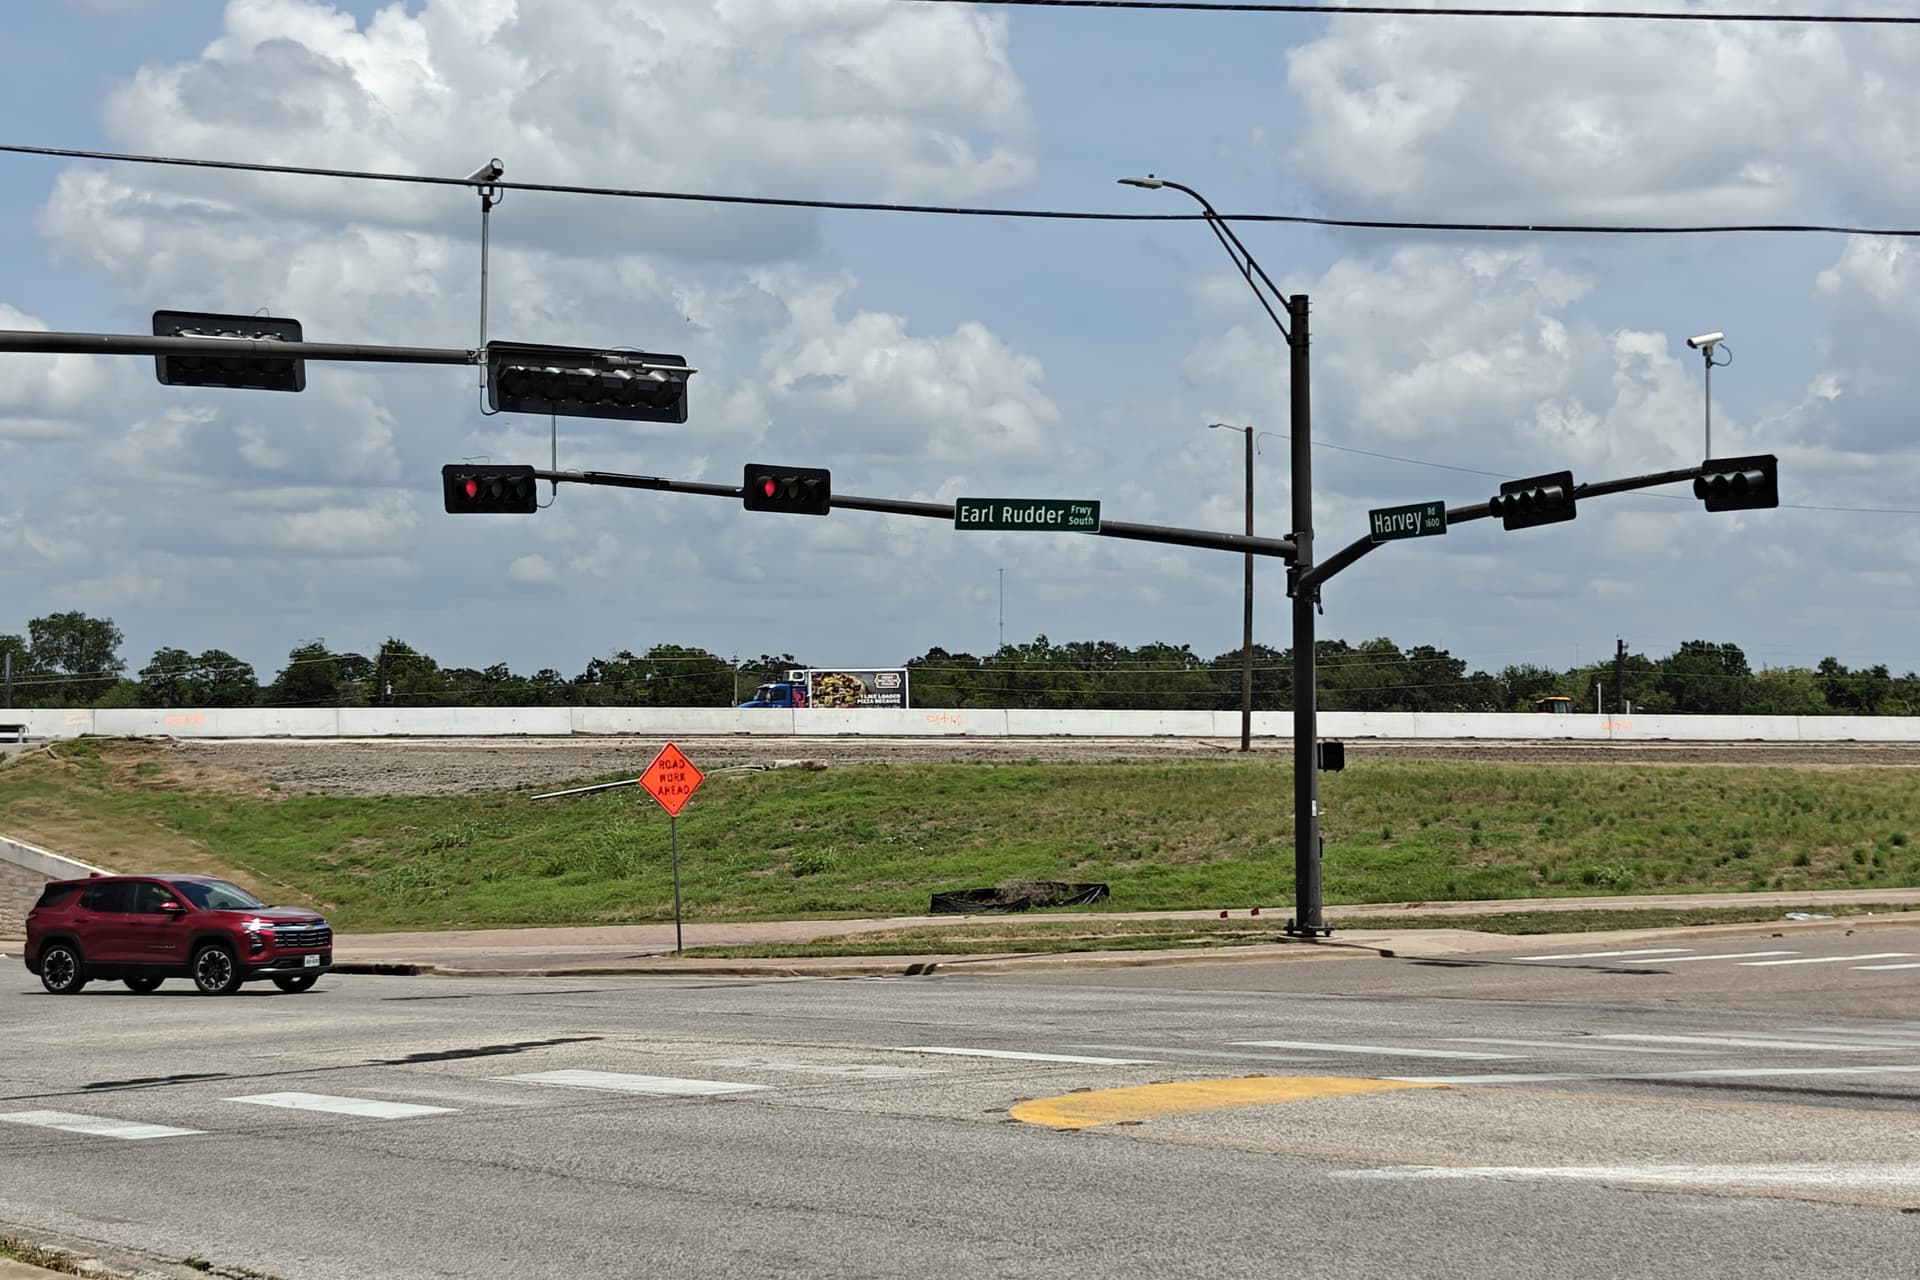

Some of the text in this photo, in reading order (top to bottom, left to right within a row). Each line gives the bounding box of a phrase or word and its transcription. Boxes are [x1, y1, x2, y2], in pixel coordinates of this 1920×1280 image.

[960, 505, 1064, 524] Earl Rudder
[1071, 505, 1092, 516] Frwy
[1427, 506, 1436, 516] Rd
[1068, 516, 1094, 525] South
[1374, 511, 1422, 535] Harvey
[1425, 518, 1440, 527] 1600
[659, 759, 686, 769] ROAD
[659, 773, 686, 782] WORK
[657, 785, 690, 796] AHEAD
